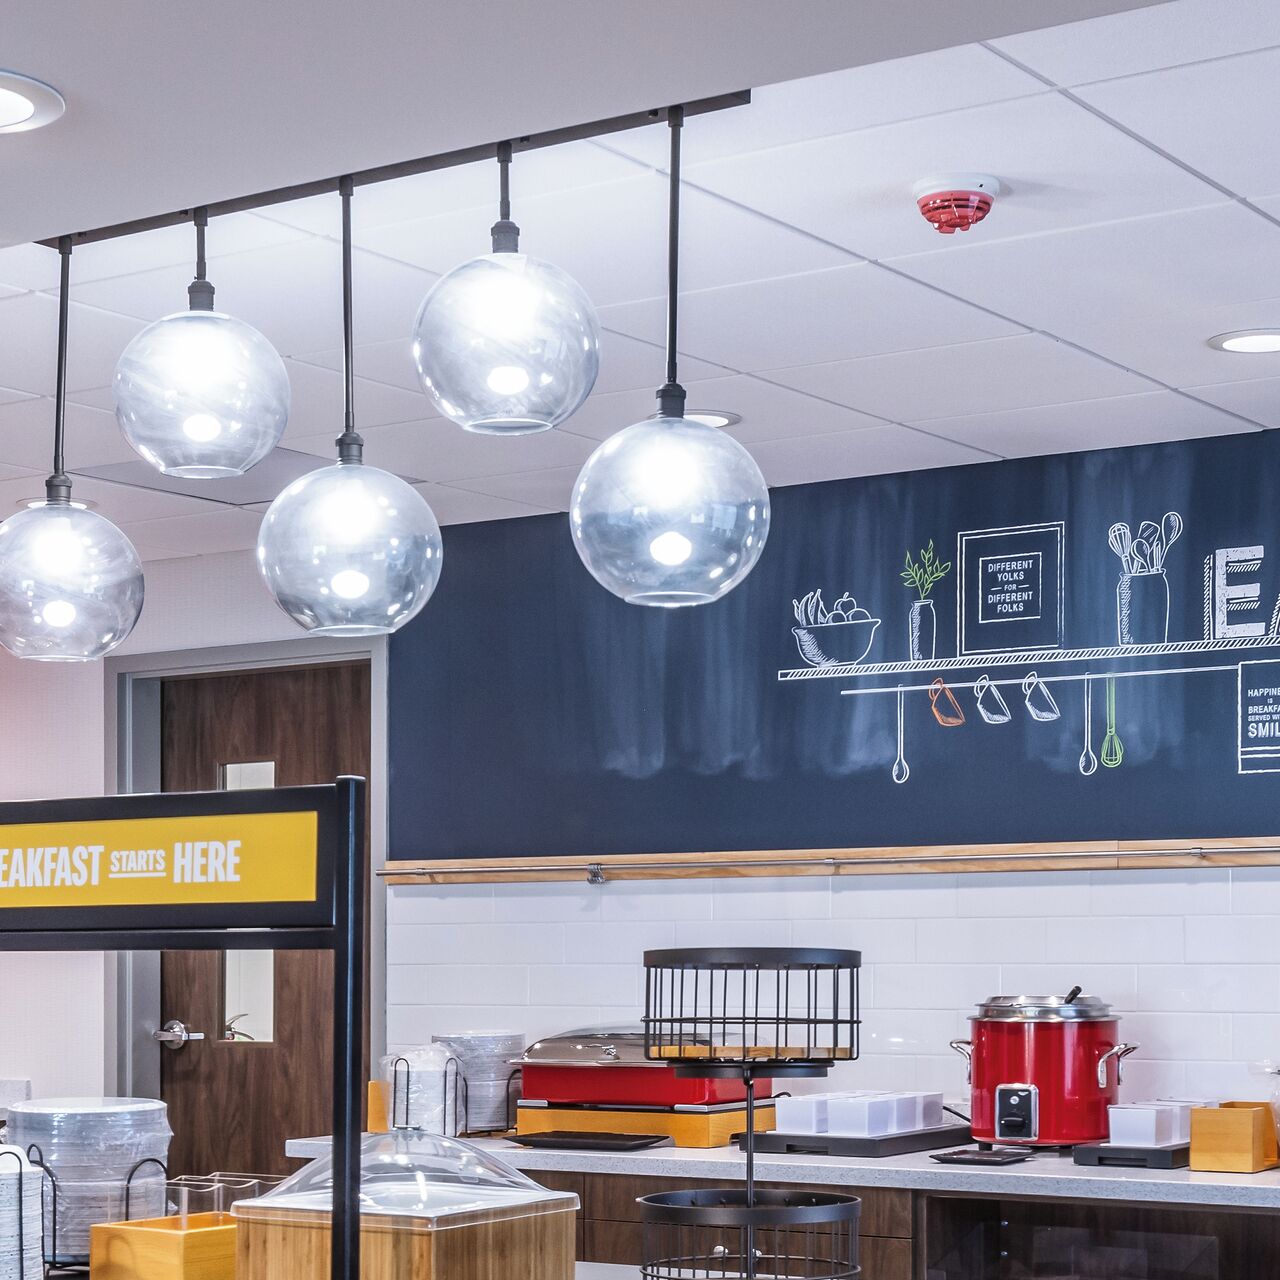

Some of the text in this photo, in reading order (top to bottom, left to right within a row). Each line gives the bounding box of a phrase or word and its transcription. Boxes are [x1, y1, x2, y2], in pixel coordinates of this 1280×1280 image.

[988, 560, 1033, 572] DIFFERENT
[997, 571, 1024, 581] YOLKS
[988, 591, 1033, 603] DIFFERENT
[997, 603, 1024, 613] FOLKS
[110, 849, 166, 873] STARTS
[173, 840, 241, 883] HERE
